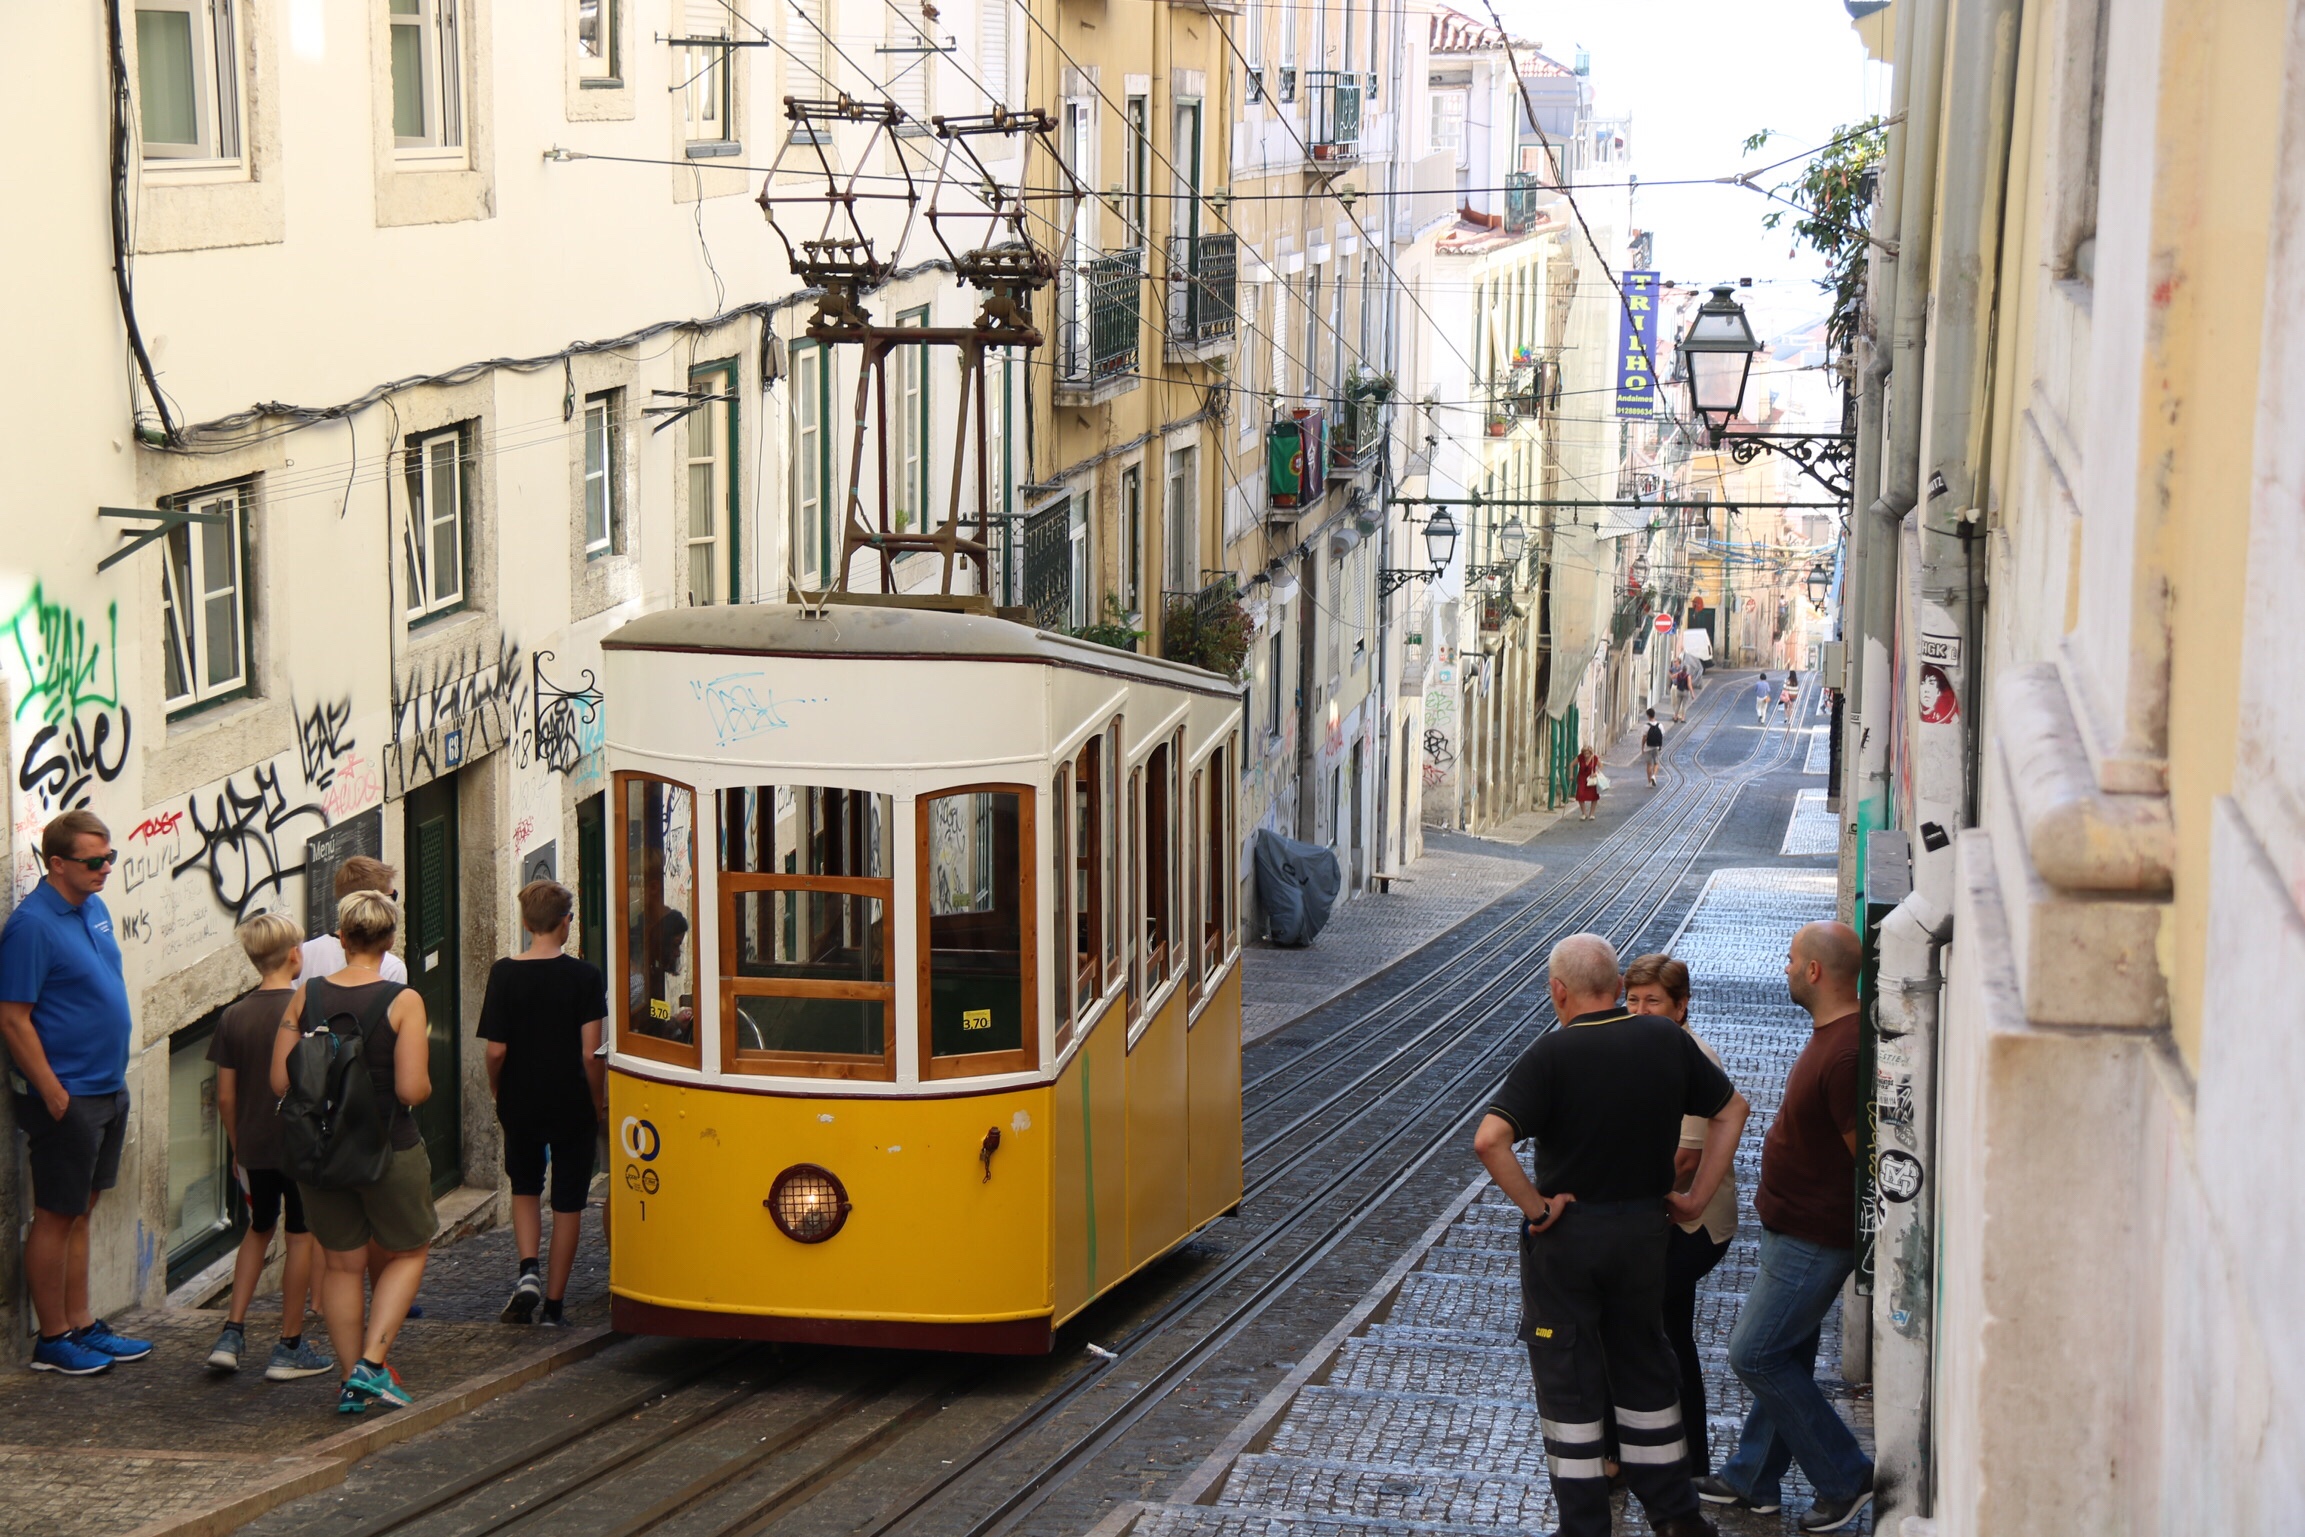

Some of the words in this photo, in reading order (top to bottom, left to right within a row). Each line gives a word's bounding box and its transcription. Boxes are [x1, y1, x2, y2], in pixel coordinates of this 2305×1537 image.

[1625, 275, 1651, 391] TRILHO
[447, 734, 460, 762] 68
[312, 833, 335, 862] Menú
[963, 1017, 988, 1030] 3,70
